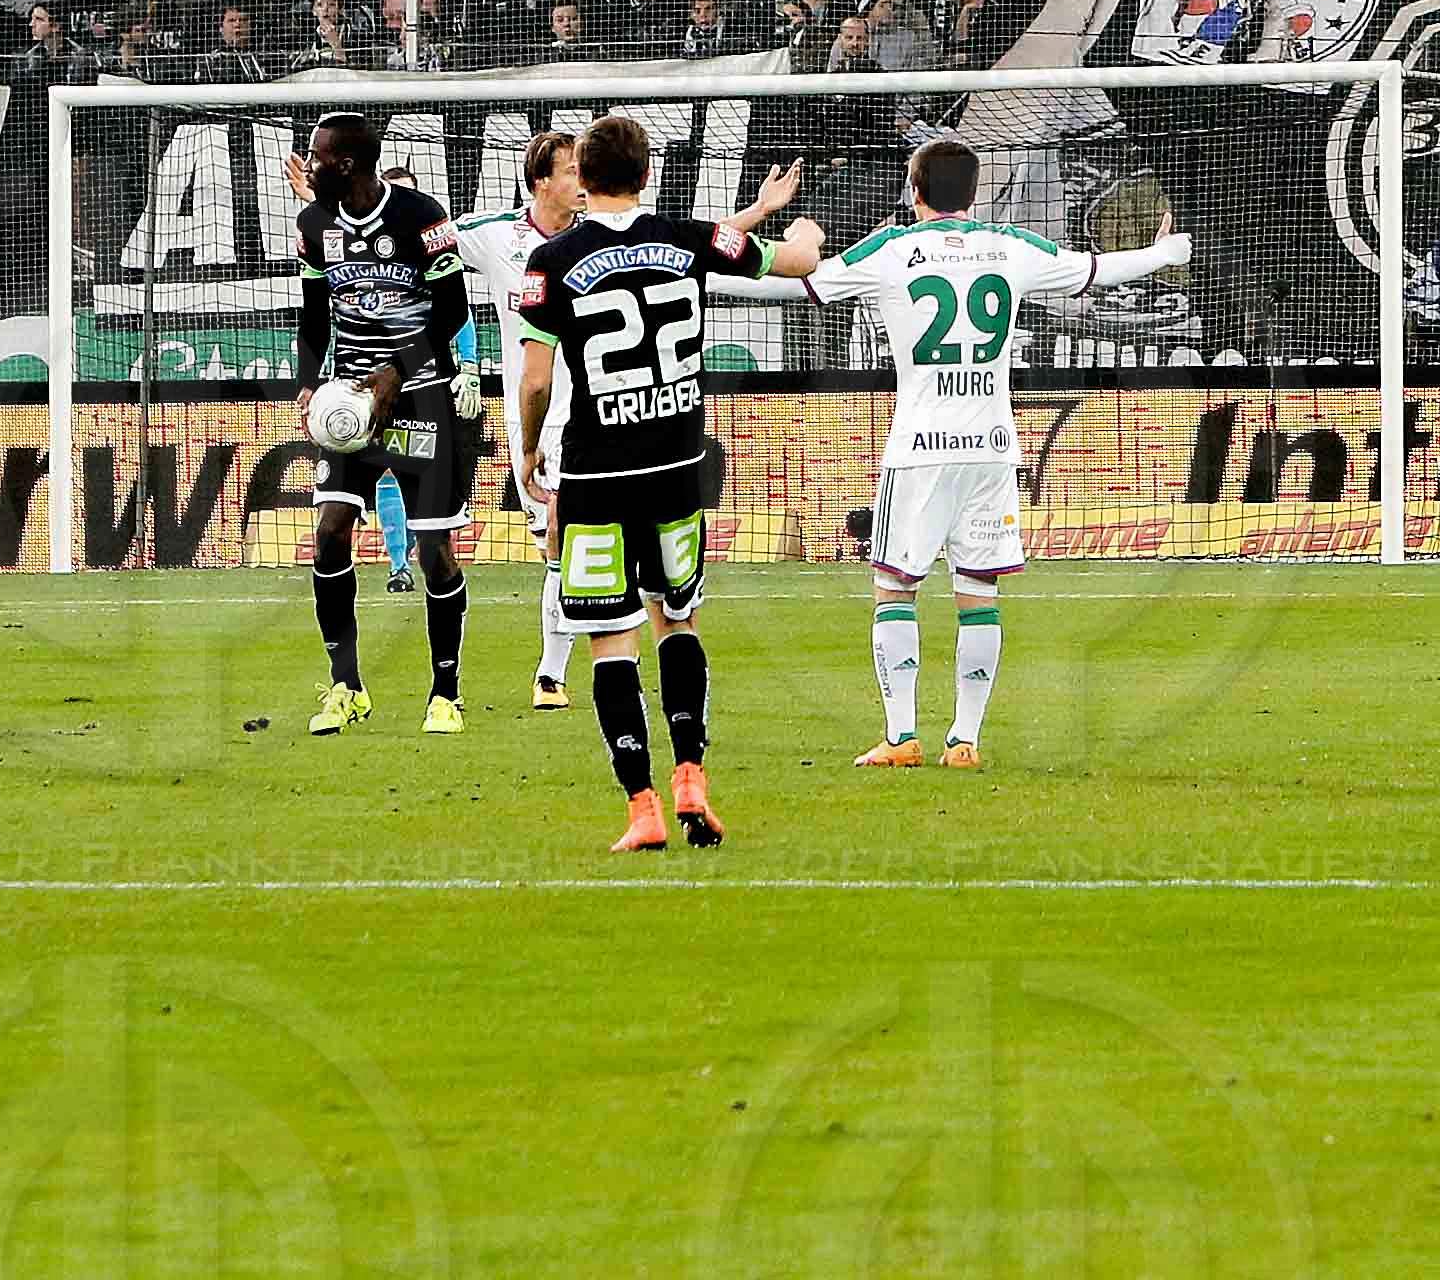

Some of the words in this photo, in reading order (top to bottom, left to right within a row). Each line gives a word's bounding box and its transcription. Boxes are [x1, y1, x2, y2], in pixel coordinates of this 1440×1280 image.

[569, 243, 692, 292] PUNTIGAMER
[571, 277, 702, 395] 22
[908, 274, 1016, 365] 29
[937, 371, 995, 398] MURG
[392, 418, 438, 432] HOLDING
[596, 389, 704, 426] GRUBER
[912, 429, 985, 452] Allianz
[568, 524, 617, 589] E
